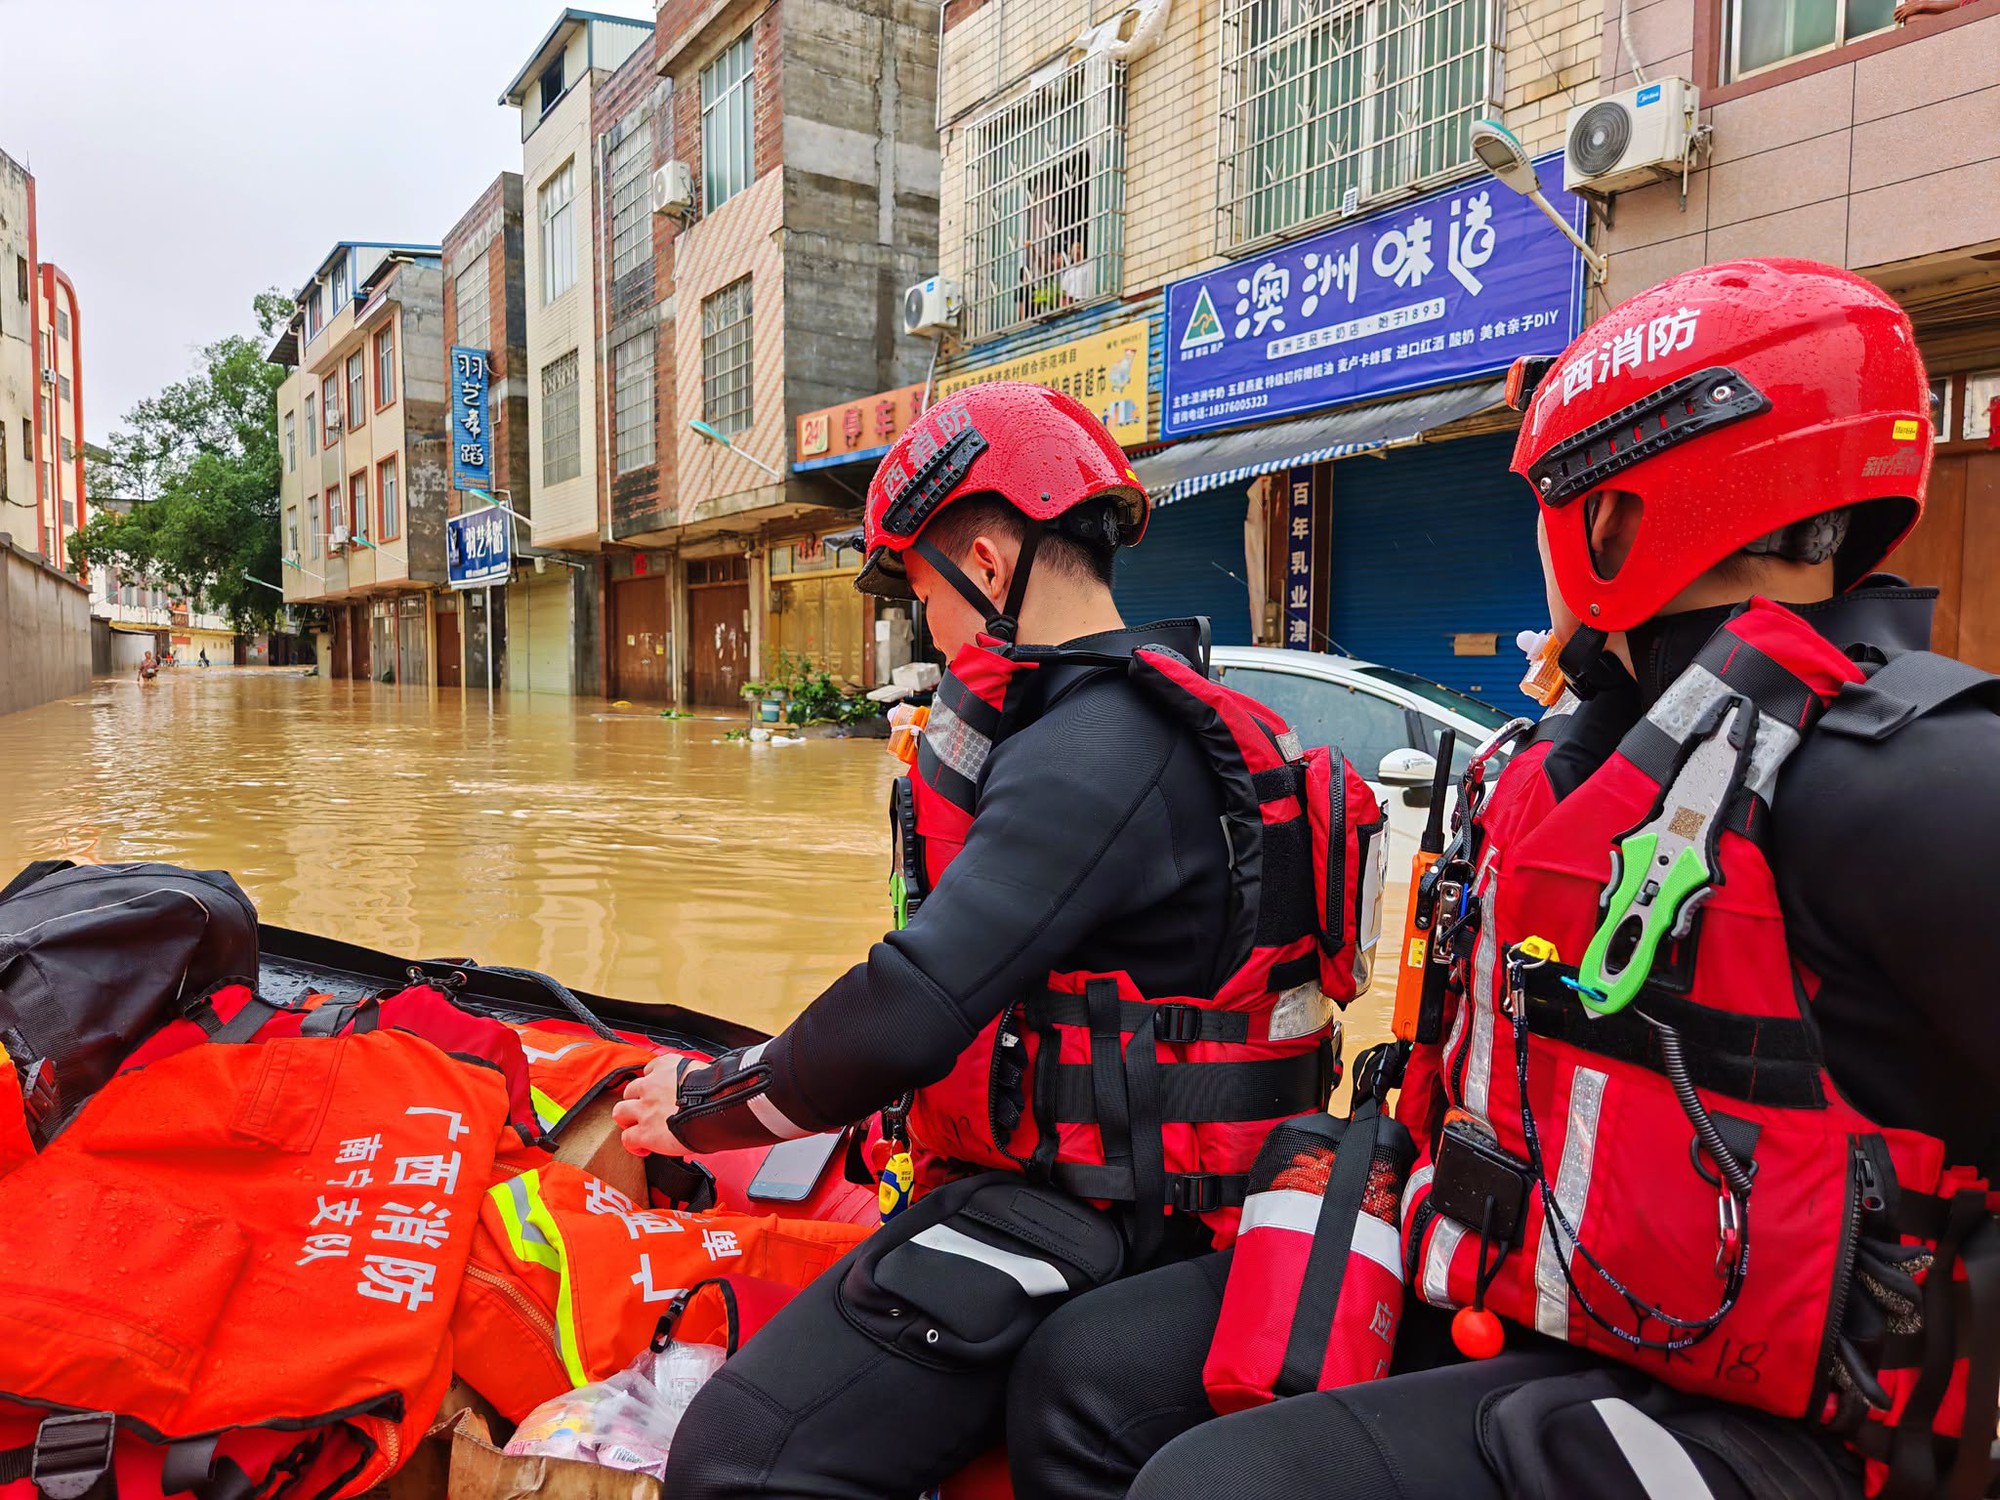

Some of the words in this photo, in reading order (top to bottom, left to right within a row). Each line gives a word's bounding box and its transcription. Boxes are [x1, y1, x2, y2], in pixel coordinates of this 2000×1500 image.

[1235, 191, 1496, 340] 澳洲味道
[1396, 335, 1445, 359] 进口红酒
[1449, 329, 1475, 348] 酸奶
[1480, 309, 1559, 341] 美食亲子DIY
[1531, 306, 1701, 436] 广西消防
[457, 354, 484, 466] 羽艺舞蹈
[868, 403, 972, 535] 广西消防
[295, 1133, 383, 1266] 南宁支队
[357, 1106, 470, 1312] 广西消防
[1598, 1268, 1626, 1296] FOX40
[1738, 1244, 1750, 1276] FOX40
[1612, 1326, 1640, 1345] FOX40
[1668, 1337, 1693, 1350] FOX40
